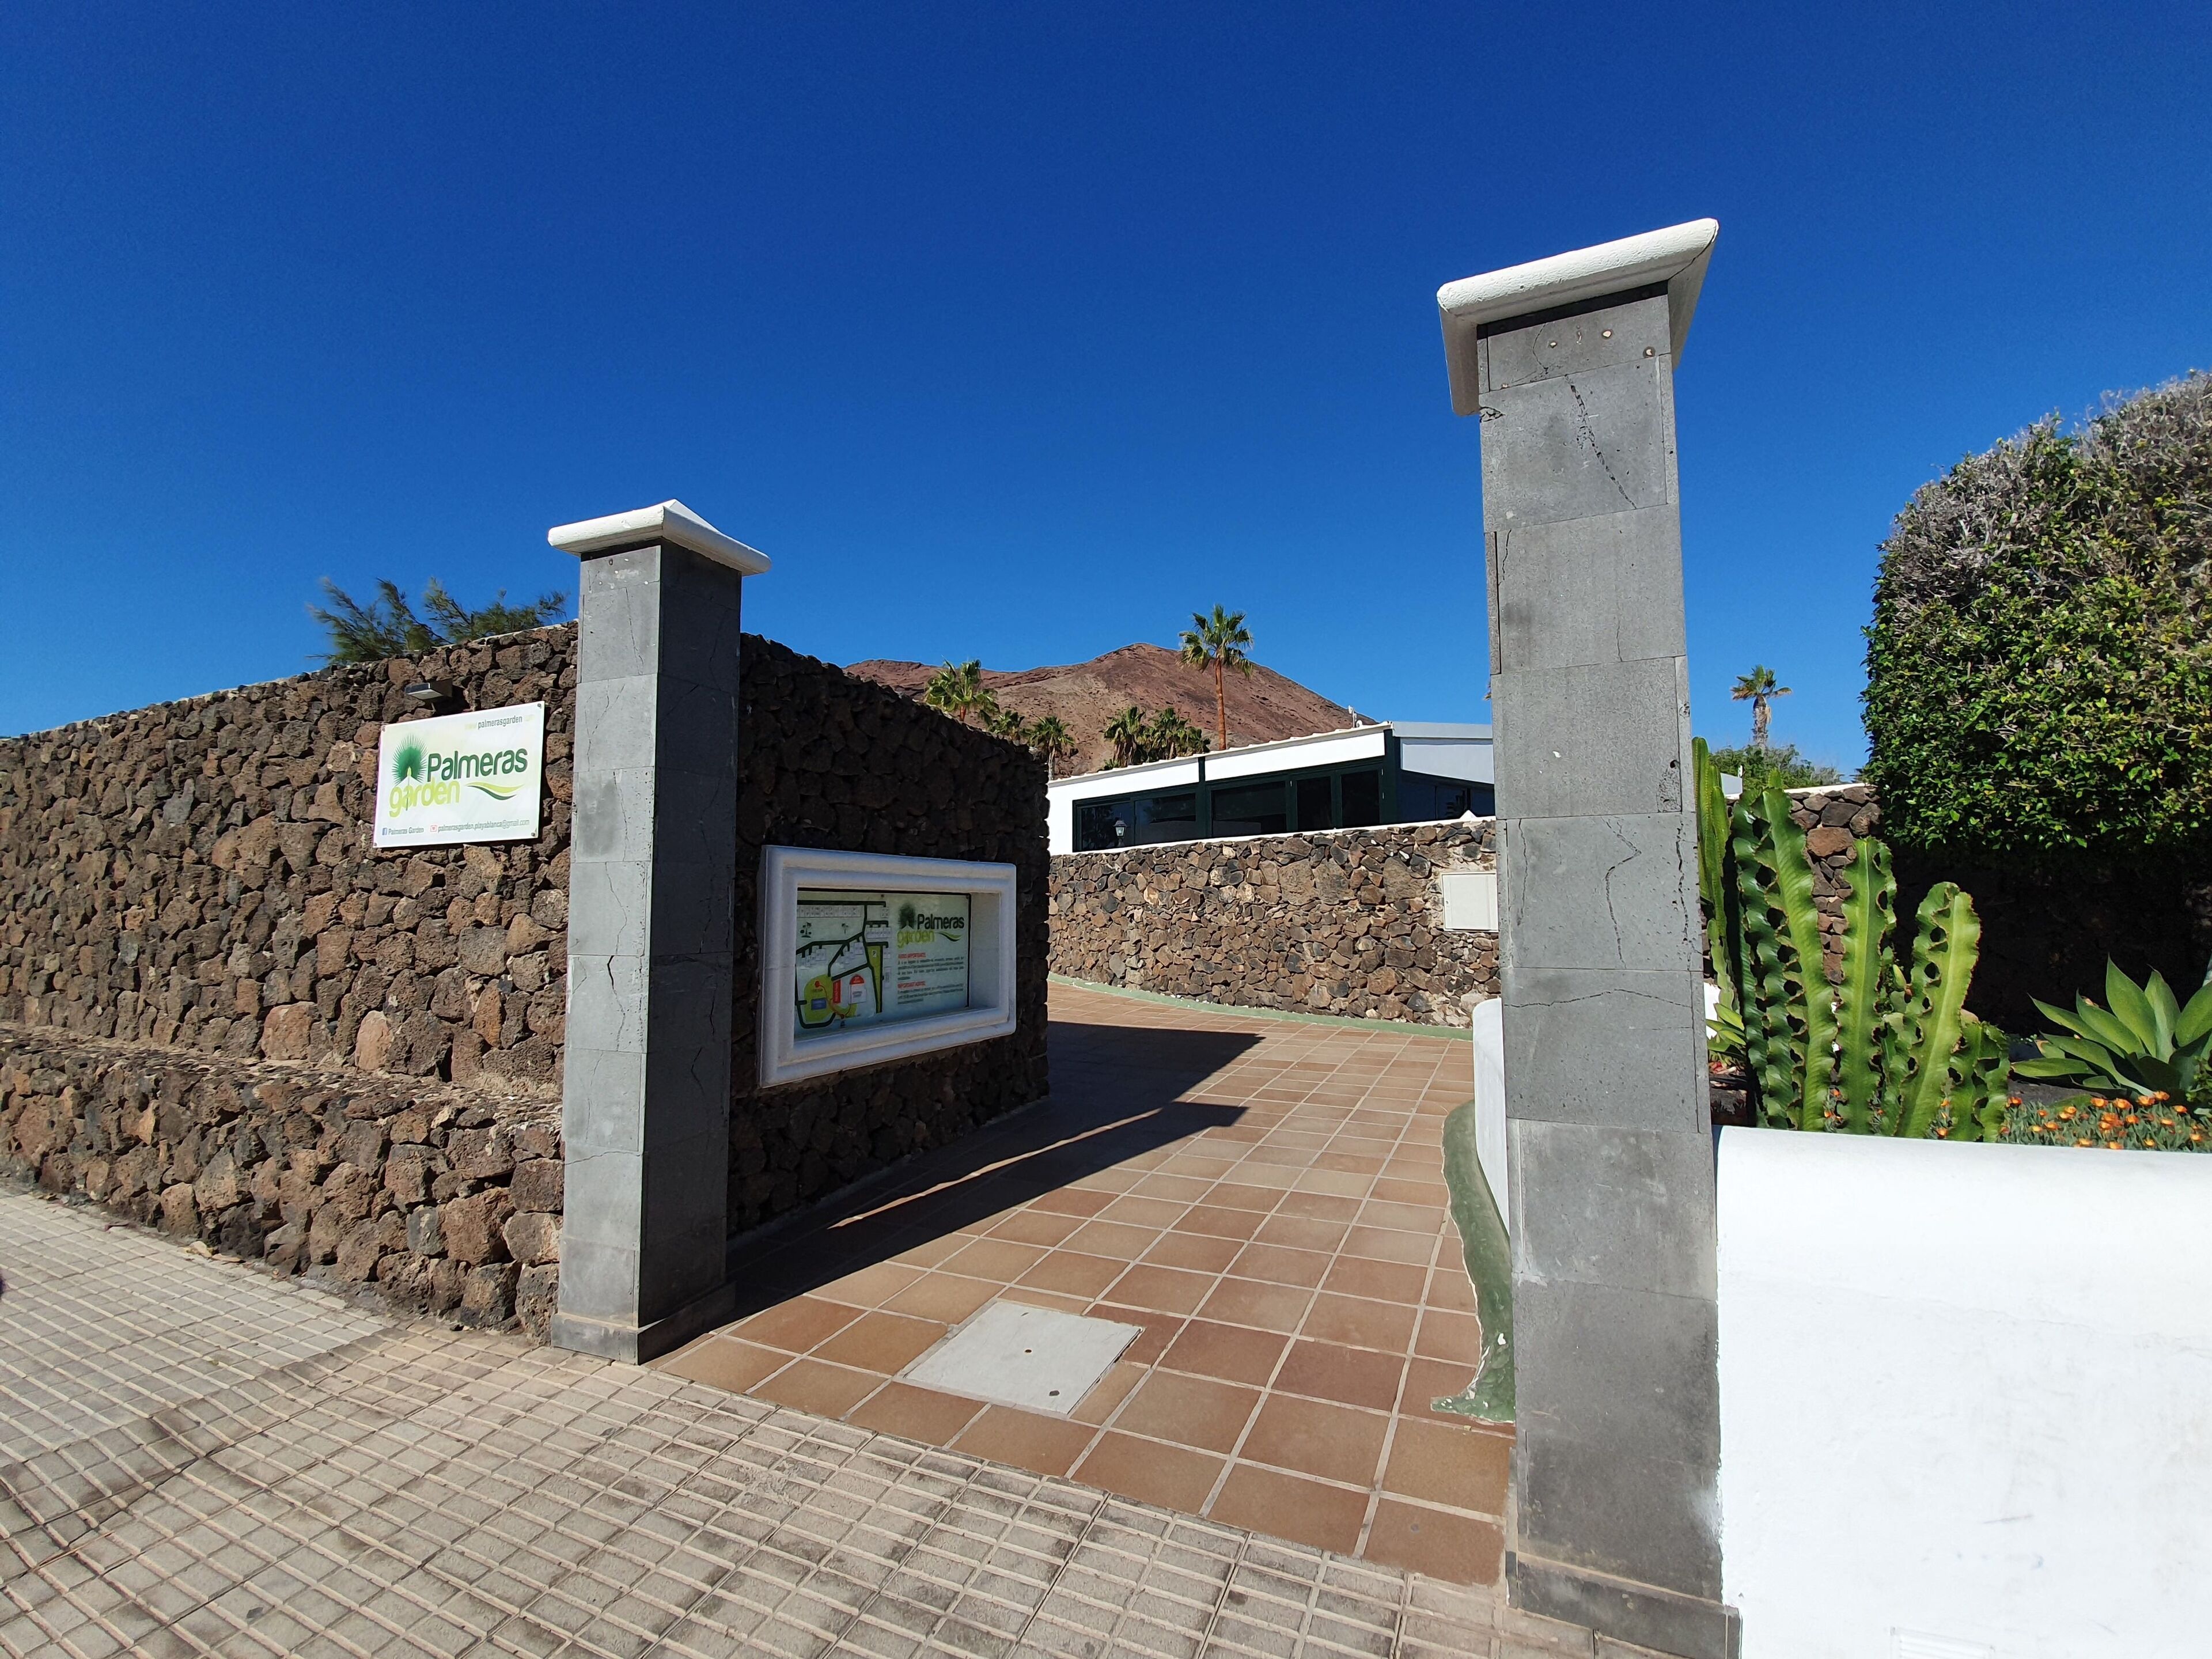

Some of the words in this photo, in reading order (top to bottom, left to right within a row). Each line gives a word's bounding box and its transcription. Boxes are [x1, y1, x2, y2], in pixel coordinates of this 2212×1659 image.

[427, 748, 528, 782] Palmeras
[389, 777, 460, 819] garden
[916, 913, 965, 930] Palmeras
[897, 928, 935, 948] garden
